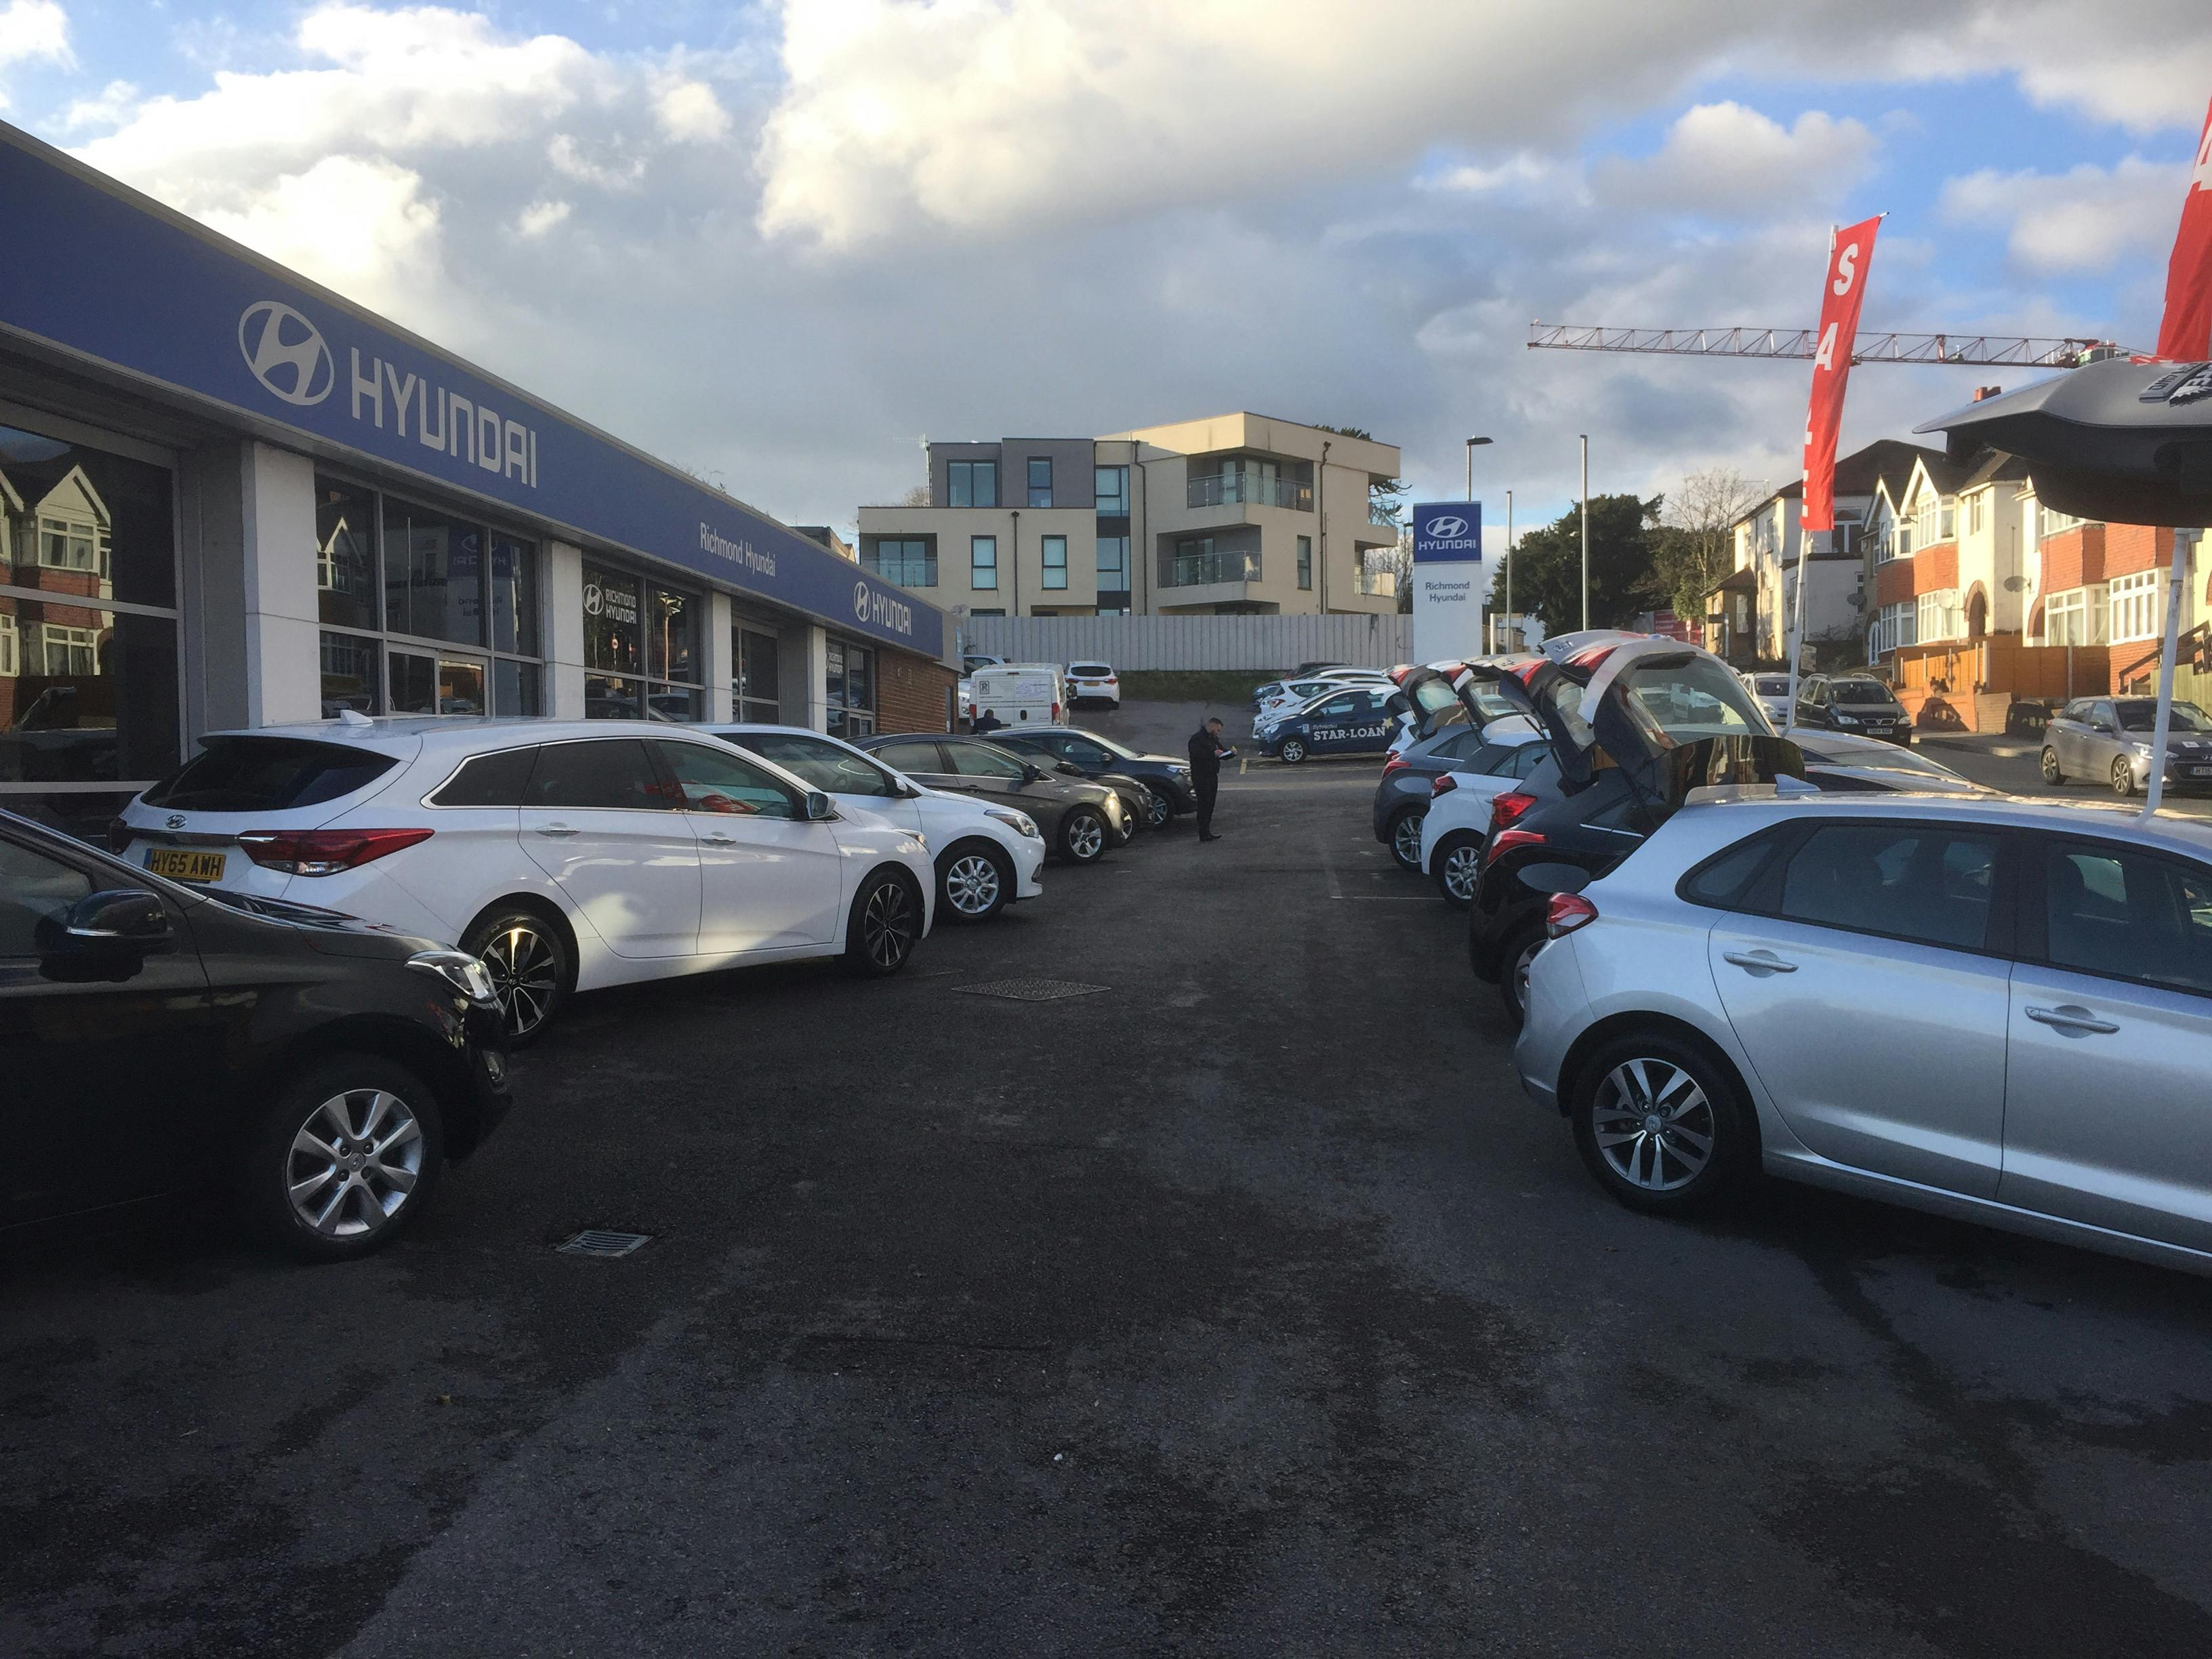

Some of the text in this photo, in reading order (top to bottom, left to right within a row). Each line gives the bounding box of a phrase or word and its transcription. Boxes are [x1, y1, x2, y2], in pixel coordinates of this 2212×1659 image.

[1801, 243, 1859, 518] SA
[350, 346, 537, 489] HYUNDAI
[699, 521, 776, 577] Richmond Hyundai
[1418, 539, 1477, 551] HYUNDAI
[1425, 581, 1470, 591] Richmond
[605, 588, 636, 609] RICHMOND
[1429, 592, 1466, 604] Hyundai
[606, 604, 637, 625] HYUNDAI
[872, 591, 912, 636] HYUNDAI
[1313, 726, 1386, 741] STAR-LOAN
[151, 852, 222, 877] HY65 AWH
